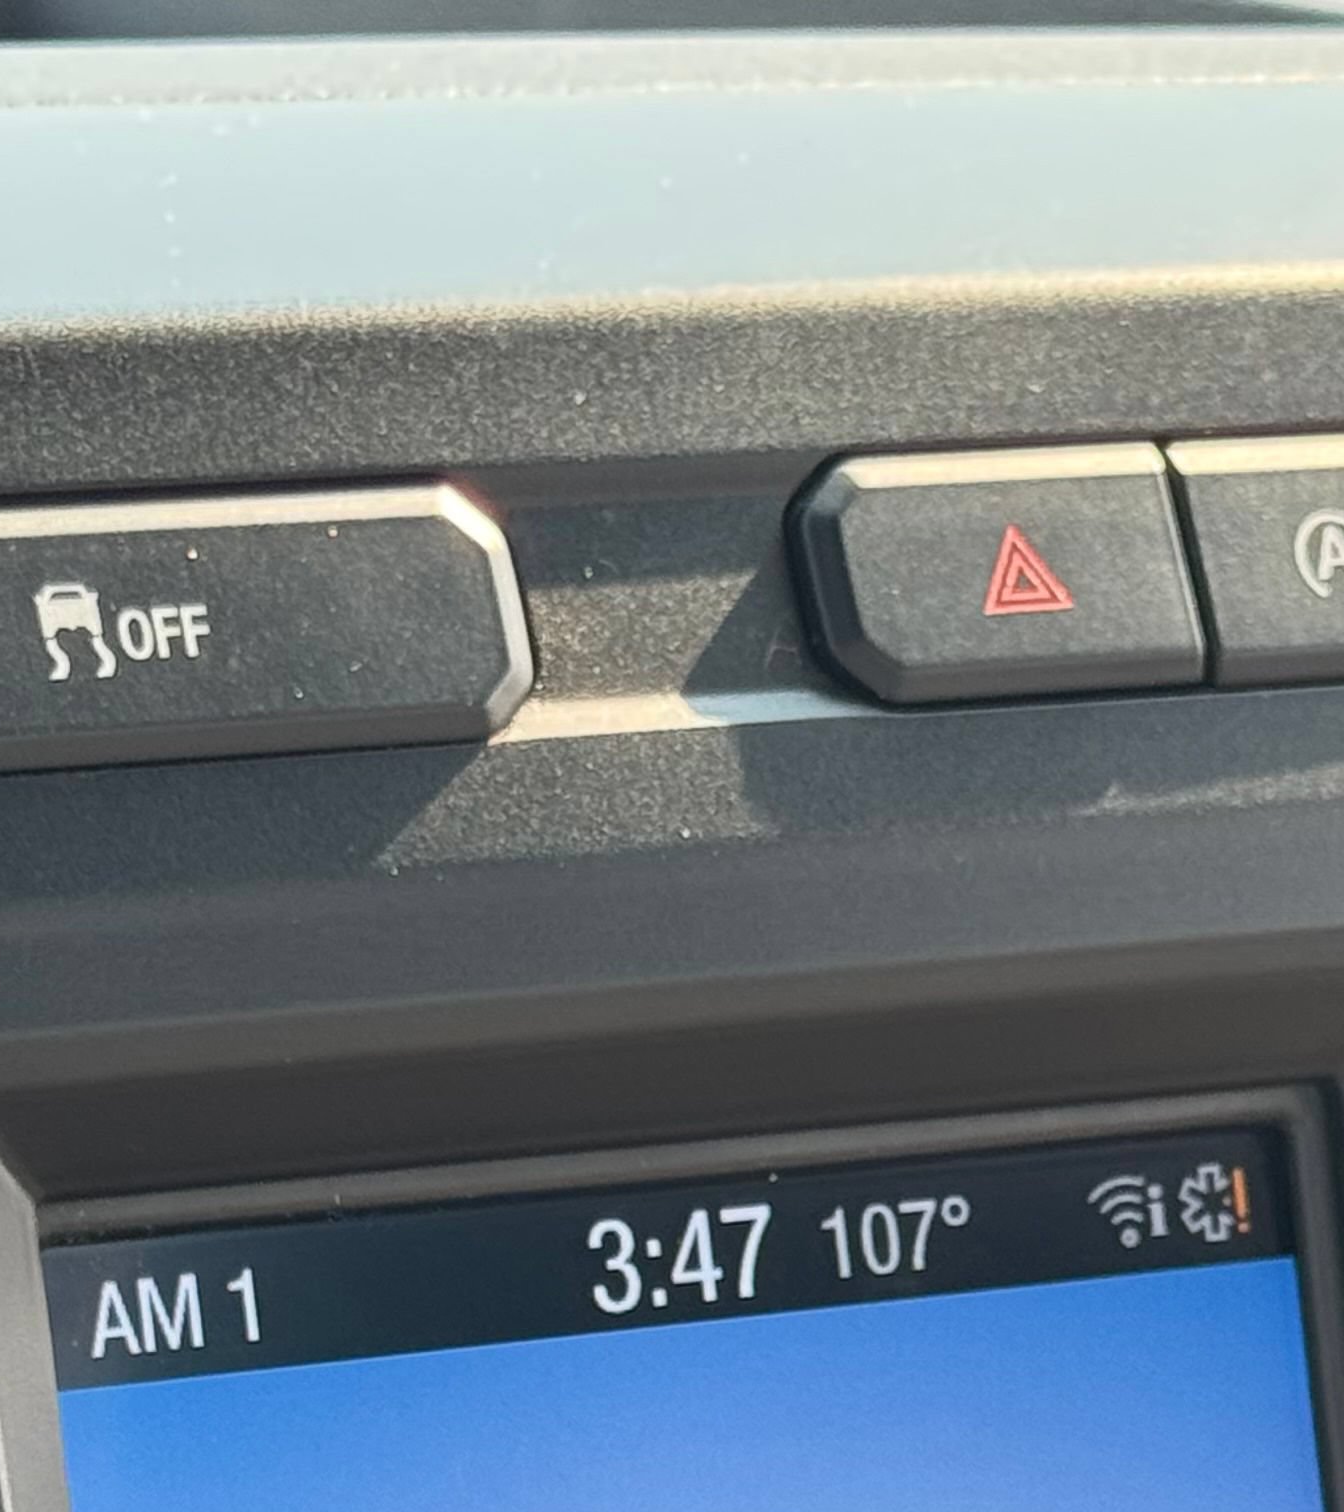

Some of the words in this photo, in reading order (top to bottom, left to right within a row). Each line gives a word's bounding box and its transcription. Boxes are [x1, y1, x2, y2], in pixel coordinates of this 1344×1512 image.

[117, 604, 211, 661] OFF
[588, 1203, 774, 1315] 3:47
[820, 1195, 973, 1280] 107°
[90, 1280, 206, 1360] AM
[226, 1268, 262, 1342] 1
